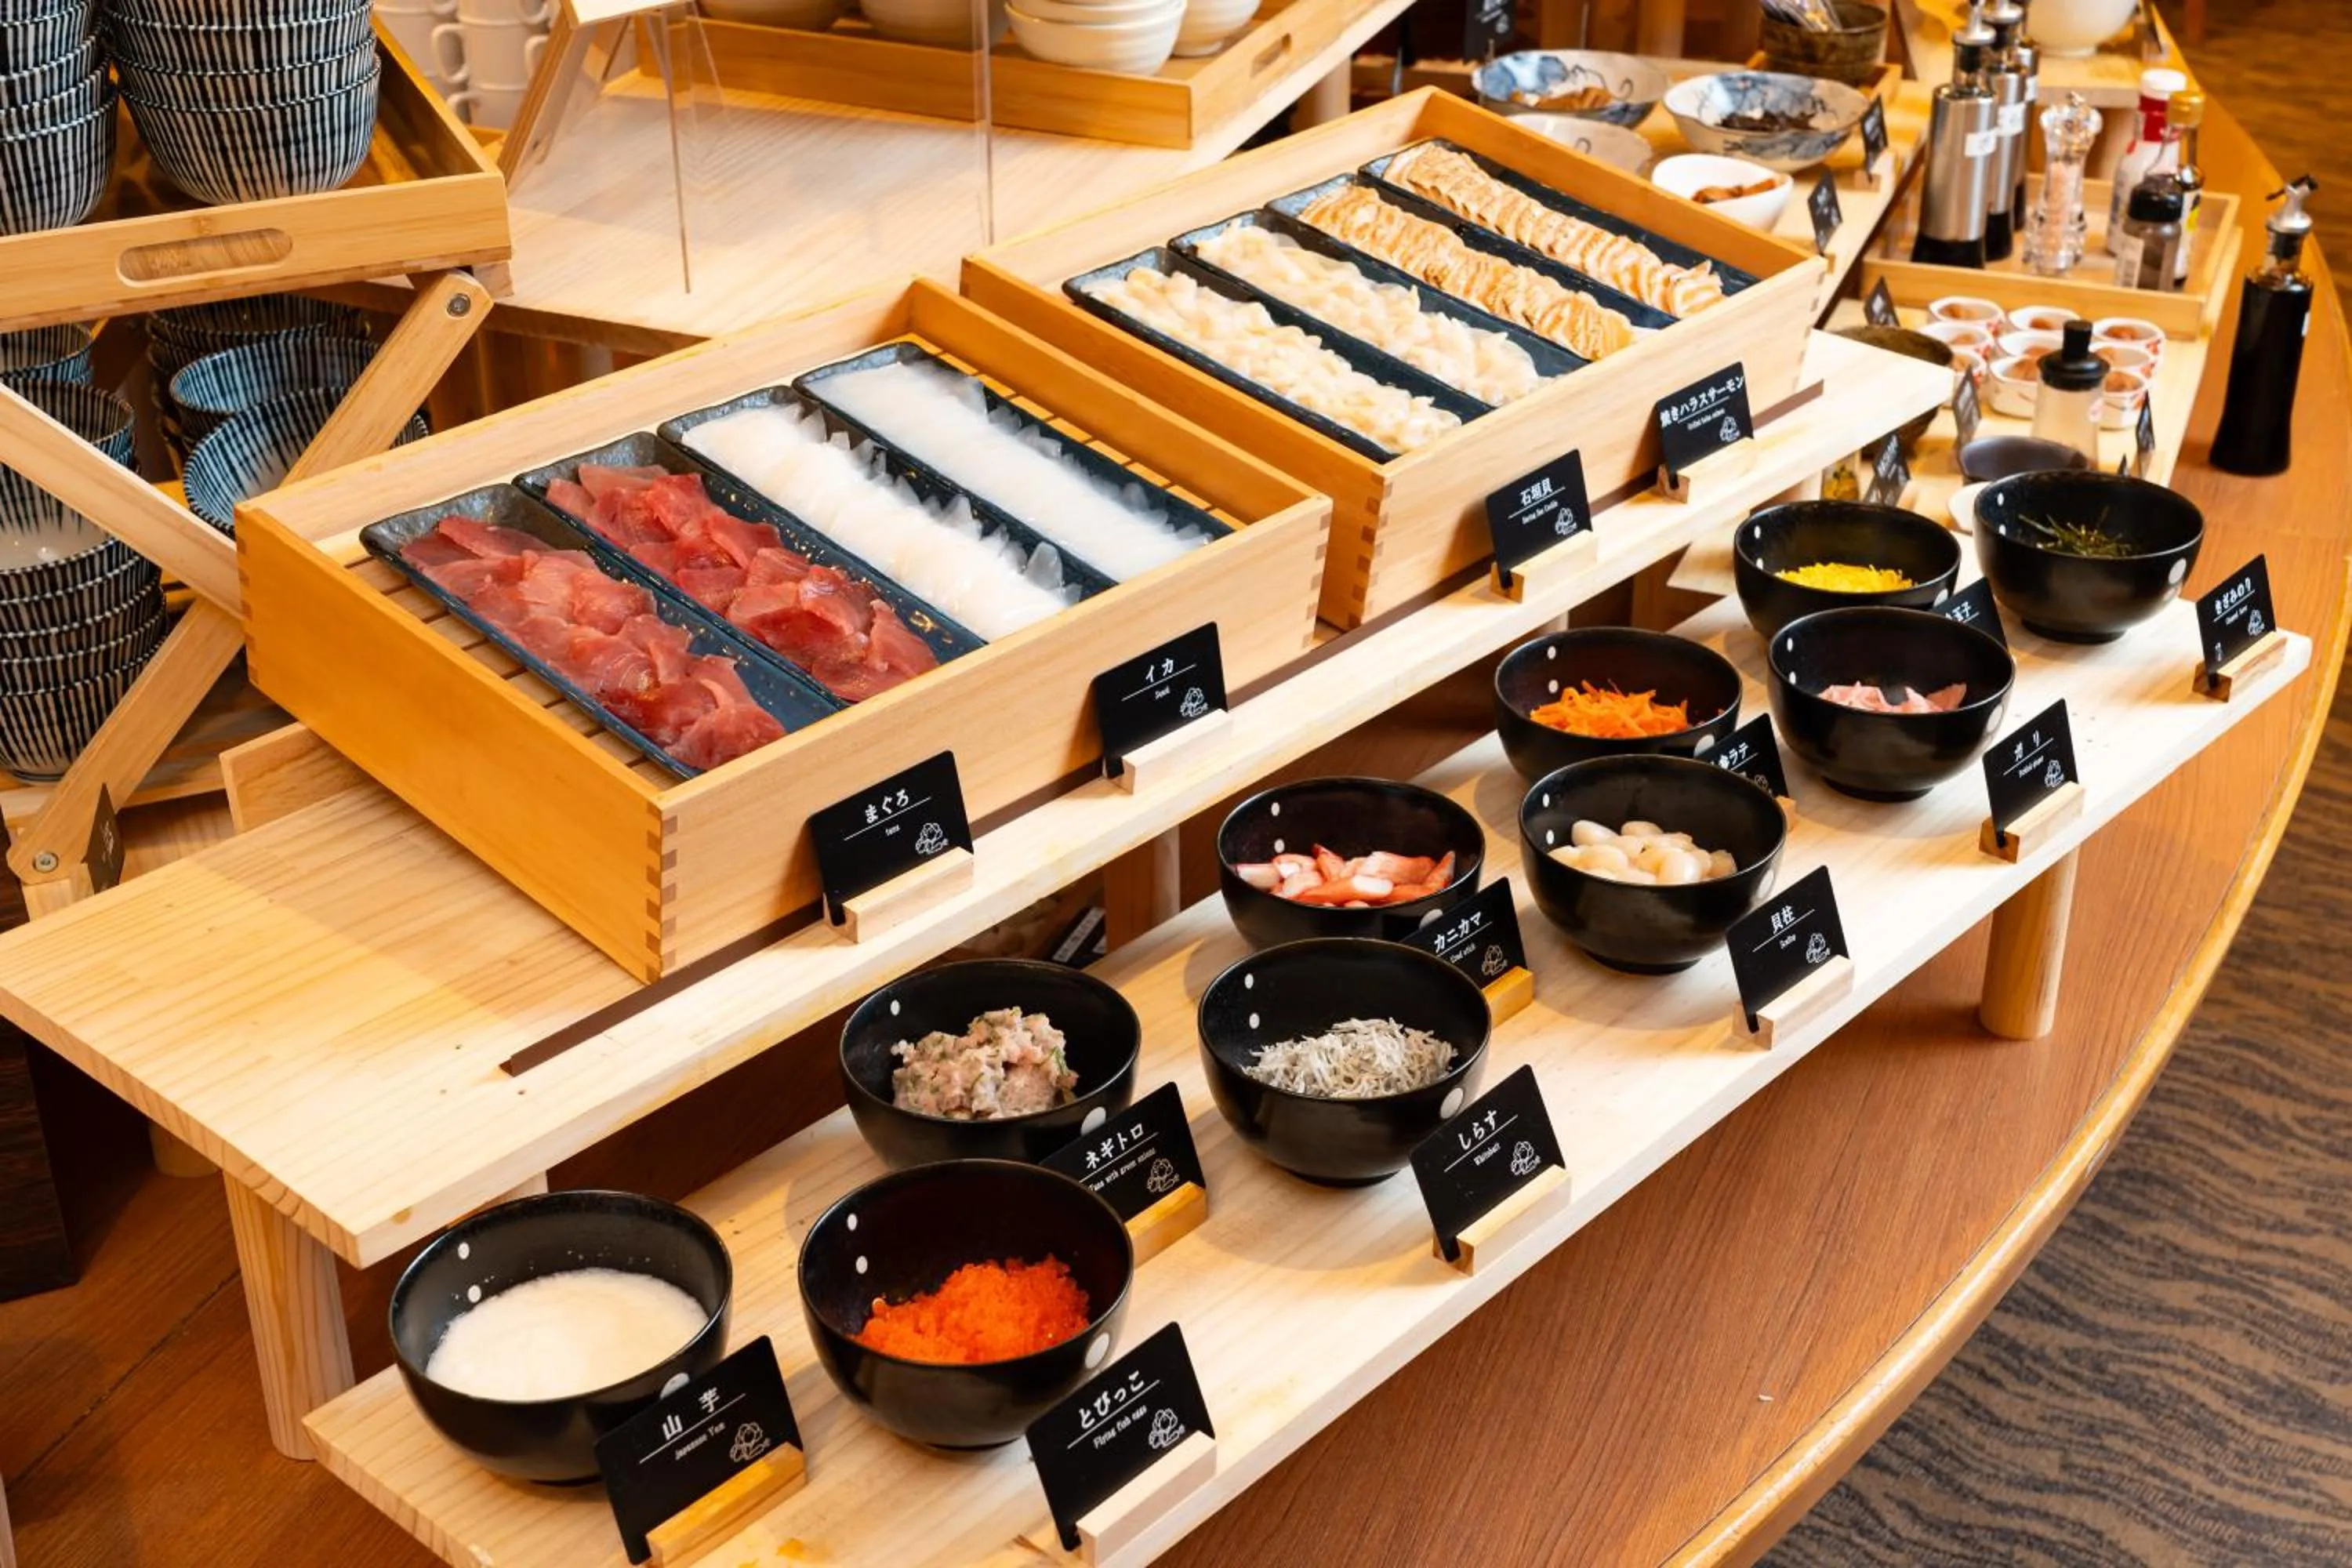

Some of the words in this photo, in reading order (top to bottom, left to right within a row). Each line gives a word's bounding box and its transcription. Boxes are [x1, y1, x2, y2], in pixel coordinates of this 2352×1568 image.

[1145, 658, 1174, 683] イカ
[865, 788, 909, 824] まぐろ
[1433, 911, 1482, 953] カニカマ
[1770, 905, 1796, 935] 貝柱
[1085, 1123, 1145, 1170] ネギトロ
[1457, 1109, 1497, 1151] しらす
[661, 1386, 720, 1441] 山芋
[1078, 1370, 1145, 1429] とびっこ
